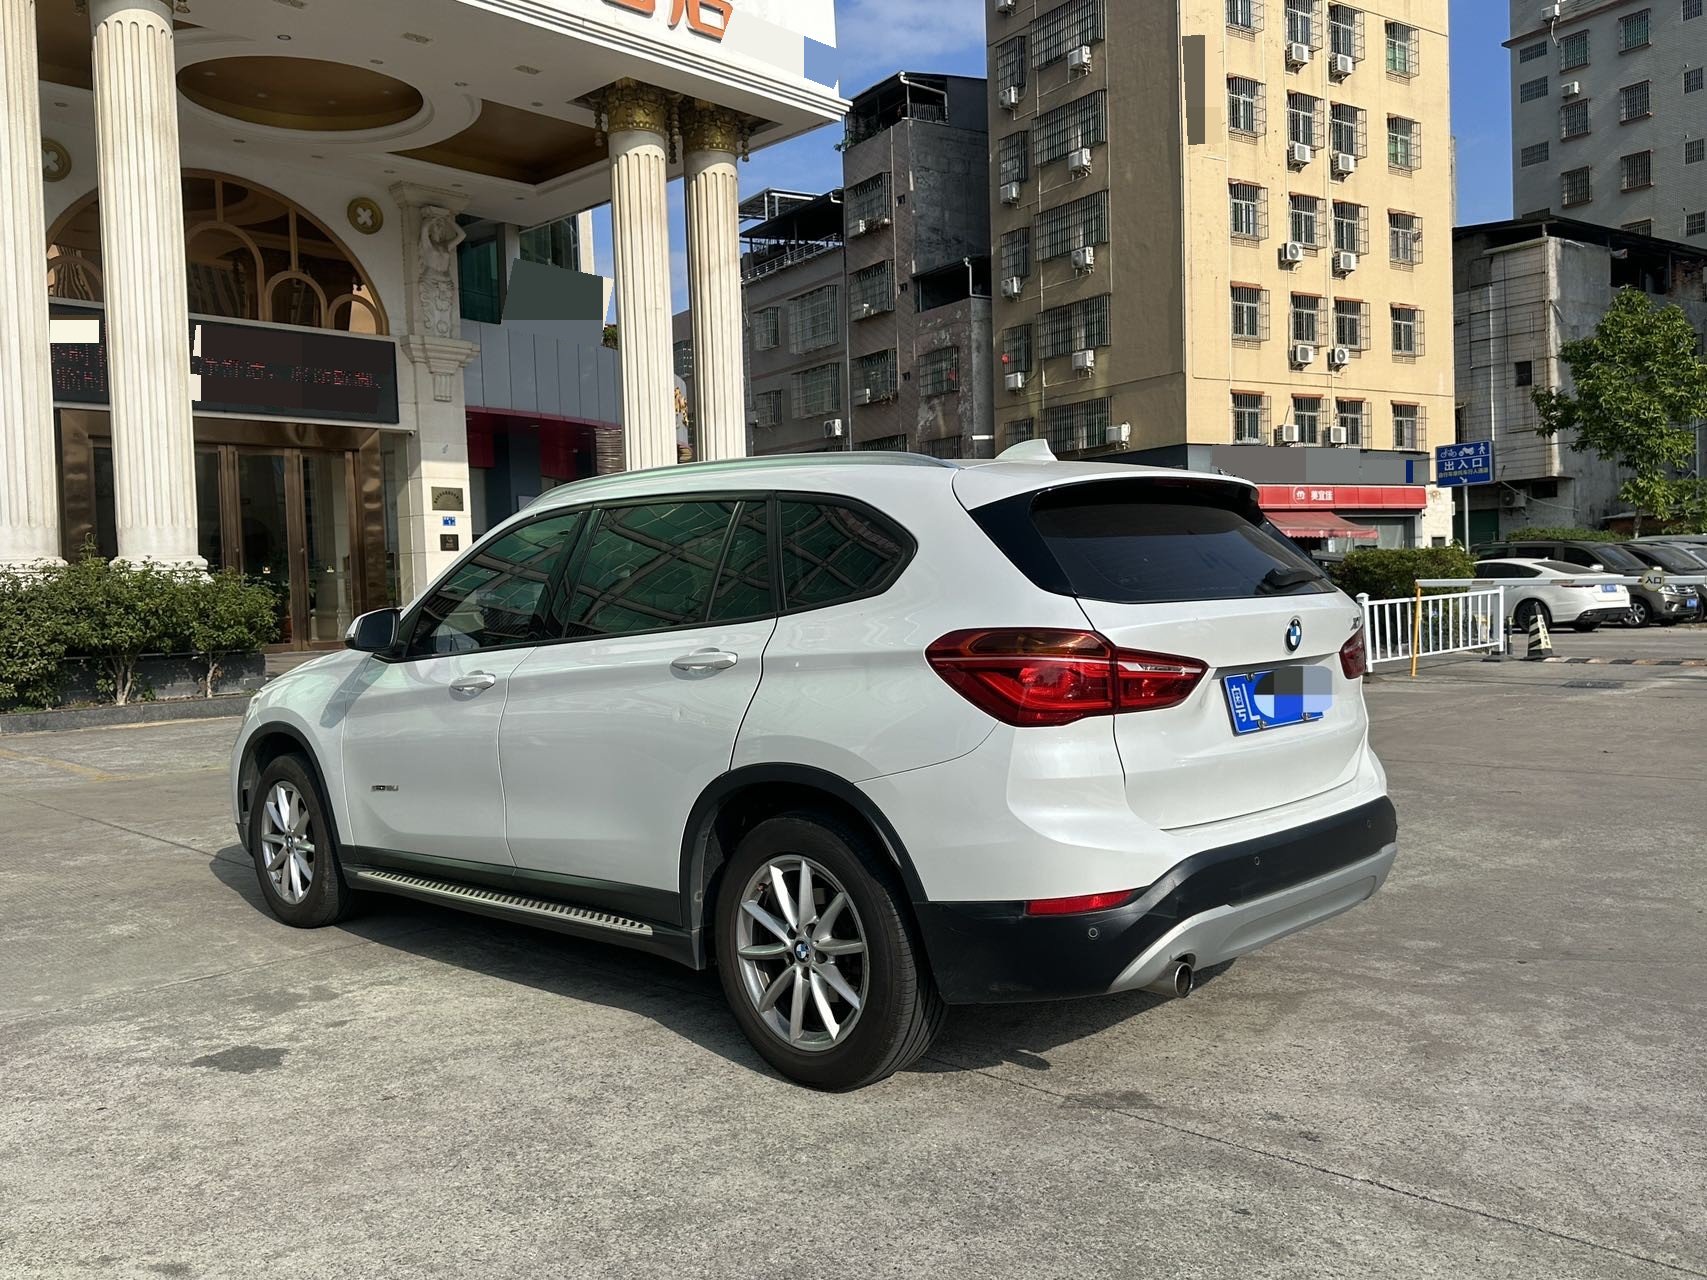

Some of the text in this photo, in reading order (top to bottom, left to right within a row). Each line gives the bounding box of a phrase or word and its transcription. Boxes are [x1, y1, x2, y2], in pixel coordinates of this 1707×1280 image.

[1444, 458, 1483, 471] 出入口
[1645, 576, 1662, 585] 入口
